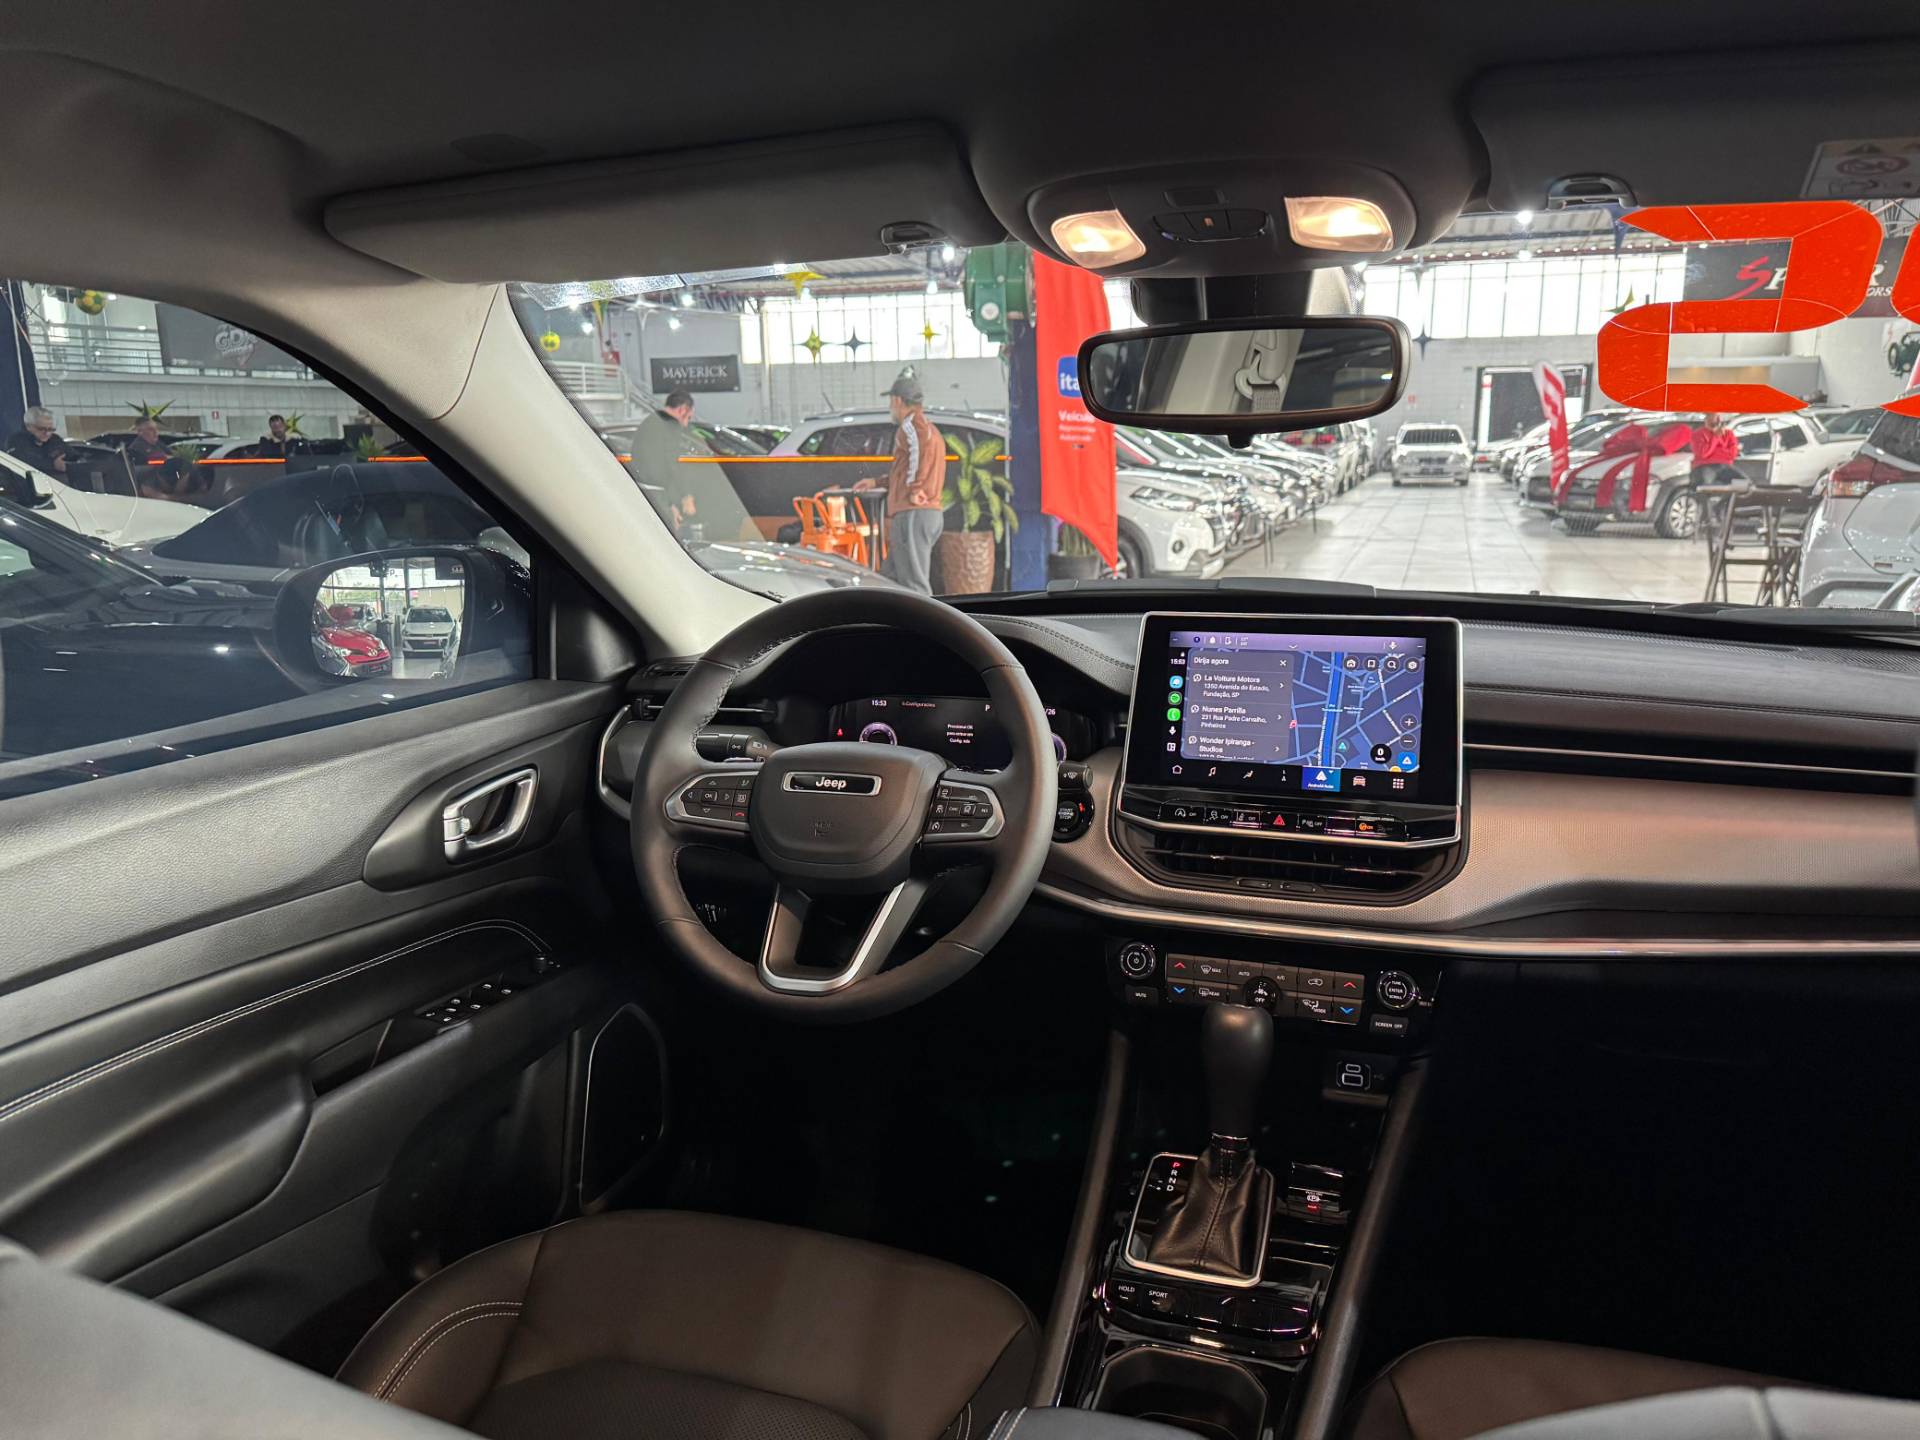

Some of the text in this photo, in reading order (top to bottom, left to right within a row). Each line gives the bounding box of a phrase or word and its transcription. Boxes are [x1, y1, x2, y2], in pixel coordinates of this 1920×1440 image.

[662, 365, 728, 379] MAVERICK
[1060, 372, 1080, 391] ita
[1193, 657, 1229, 667] Dirija agora
[985, 704, 991, 712] P
[1378, 748, 1384, 756] 0
[815, 776, 847, 790] Jeep
[1375, 1021, 1393, 1029] SCREEN
[1168, 1177, 1177, 1185] N
[1166, 1184, 1174, 1192] D
[1118, 1285, 1135, 1293] HOLD
[1148, 1289, 1169, 1299] SPORT
